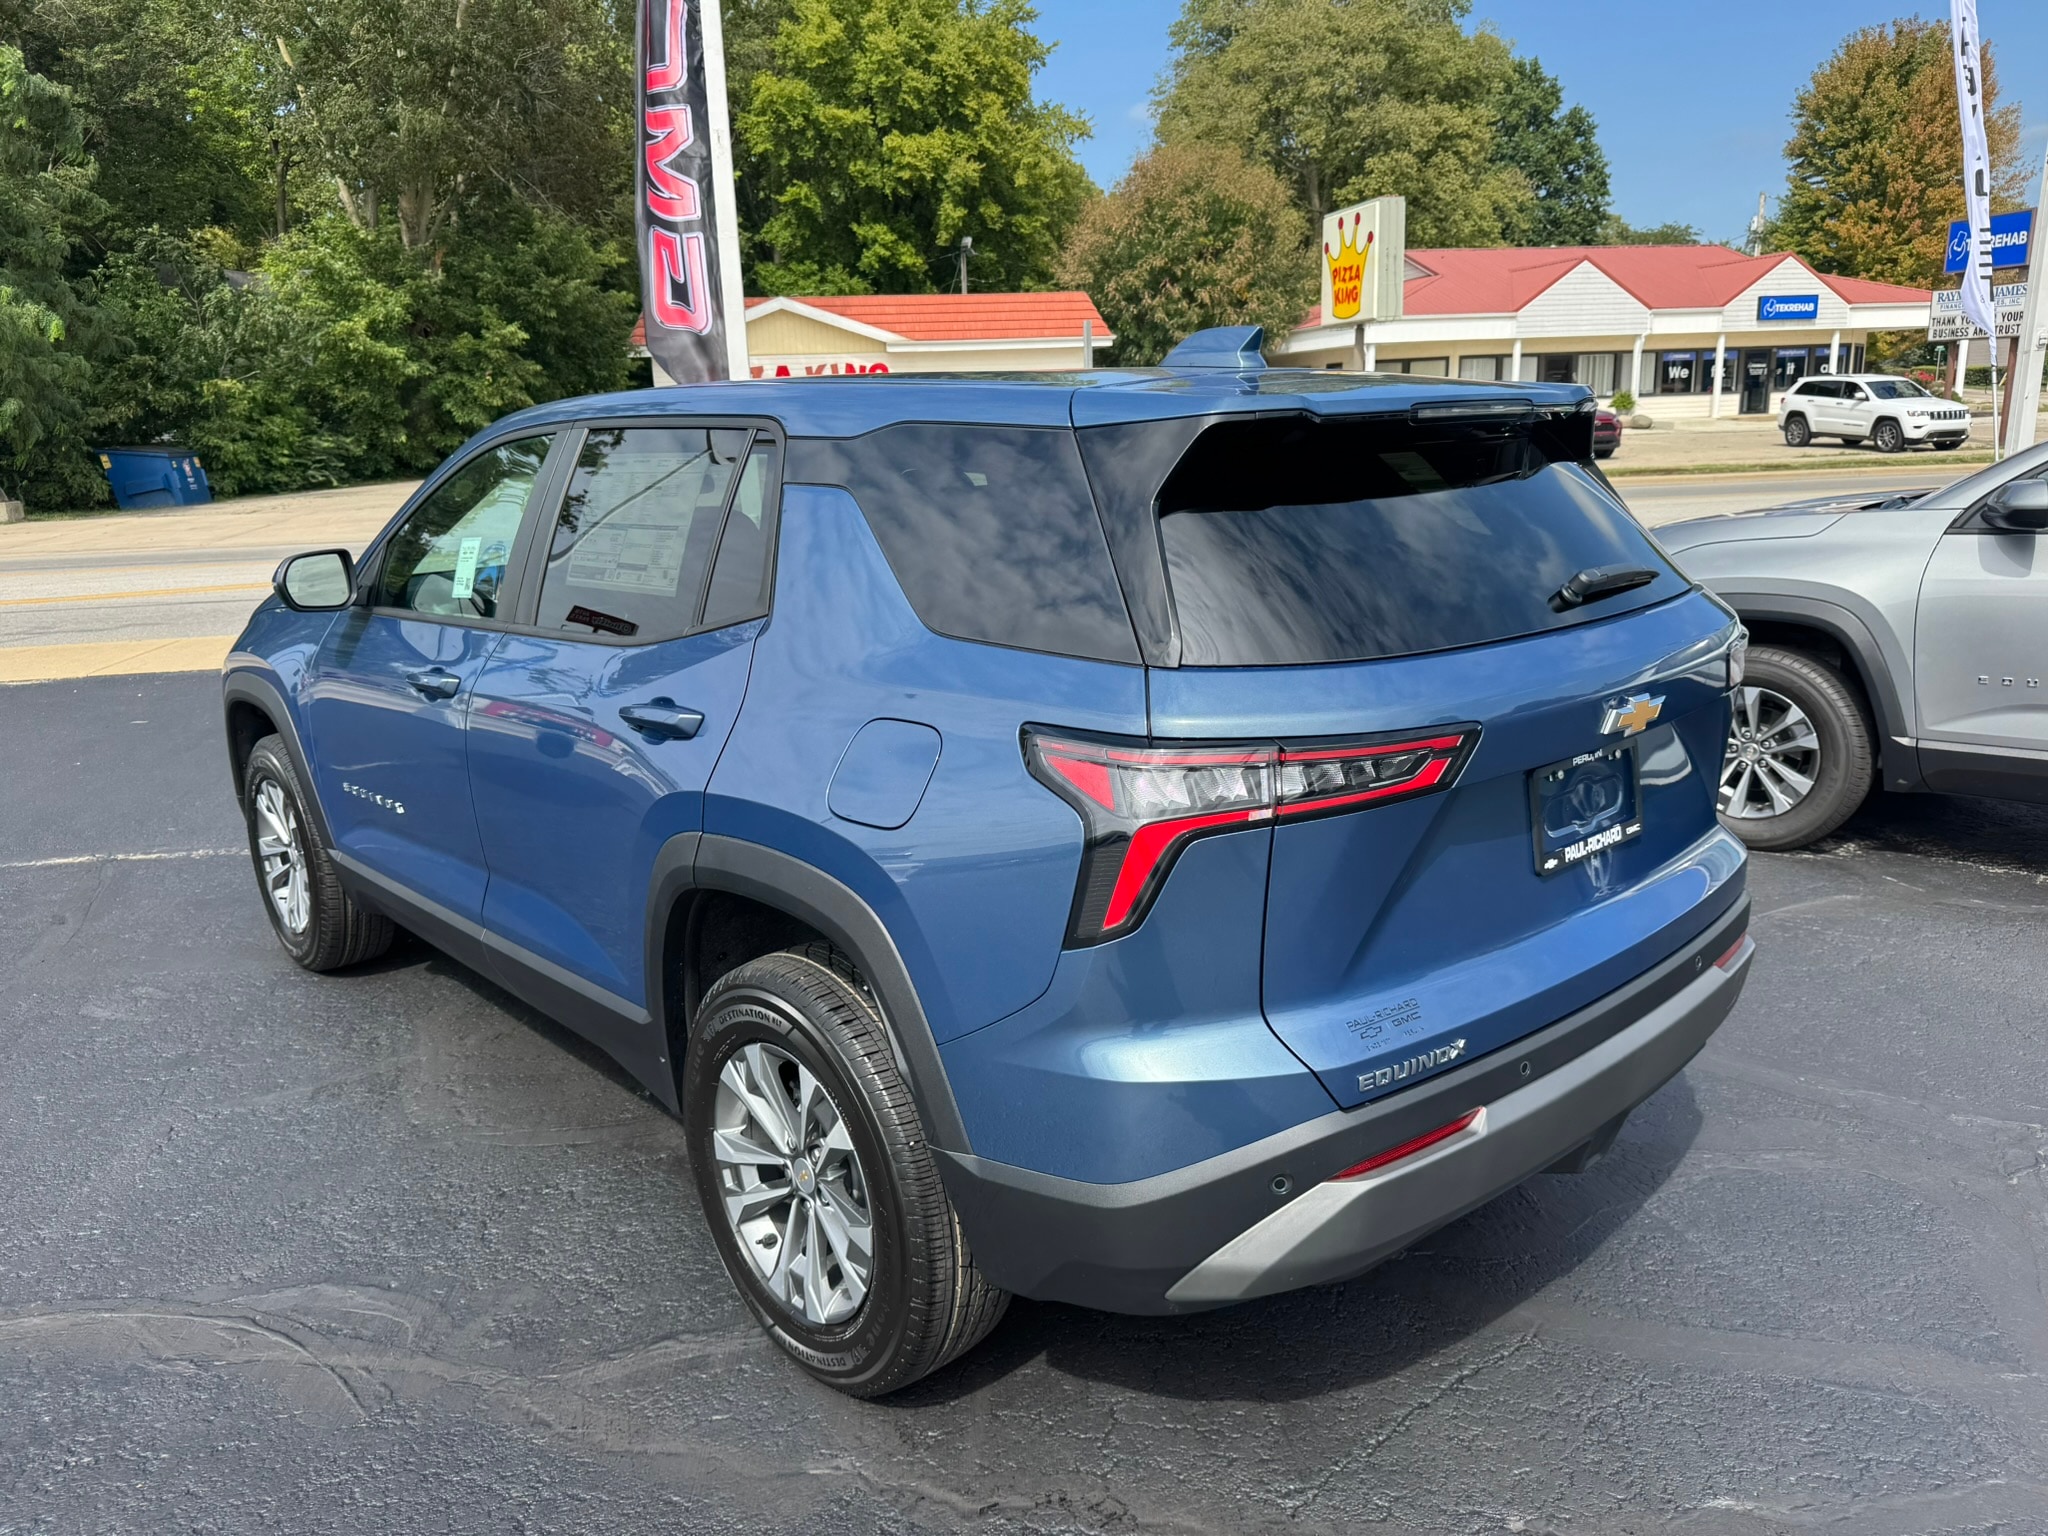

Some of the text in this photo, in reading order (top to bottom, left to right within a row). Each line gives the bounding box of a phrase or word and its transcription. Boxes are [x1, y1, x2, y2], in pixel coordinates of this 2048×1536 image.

[1966, 231, 2028, 251] TREHAB
[1332, 265, 1360, 285] PIZZA
[1334, 285, 1358, 306] KING
[1995, 284, 2028, 297] JAMES
[1776, 303, 1814, 312] TEKREHAB
[1932, 316, 1957, 327] THANK
[2001, 311, 2024, 322] YOUR
[1932, 327, 1969, 338] BUSINESS
[1668, 366, 1690, 379] We
[1710, 365, 1726, 378] fx
[1626, 823, 1641, 834] GMC
[718, 1008, 771, 1025] DESTINATION
[1392, 1011, 1422, 1027] GMC
[1357, 1038, 1467, 1092] EQUINOX
